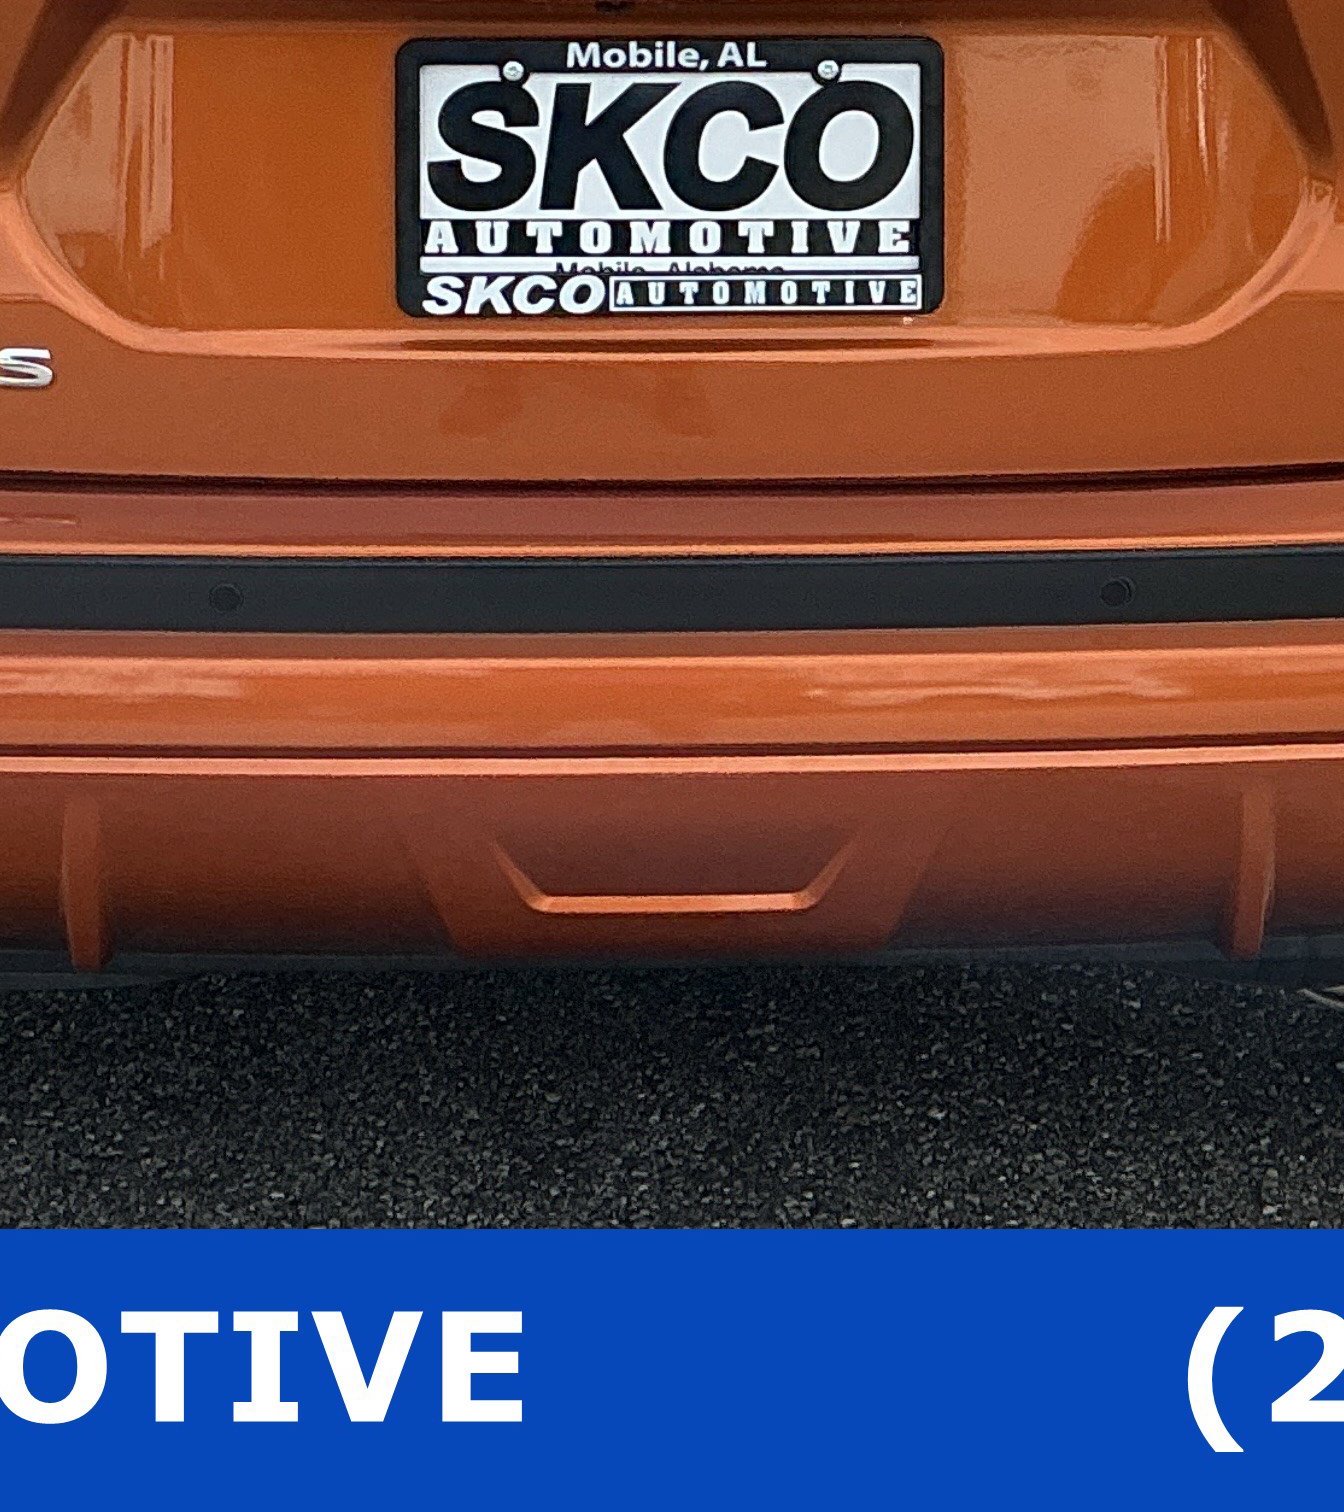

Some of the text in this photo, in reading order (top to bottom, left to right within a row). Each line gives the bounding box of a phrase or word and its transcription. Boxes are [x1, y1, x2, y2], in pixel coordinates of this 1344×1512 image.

[567, 41, 767, 71] Mobile, AL
[426, 79, 914, 212] SKCO
[424, 220, 911, 254] AUTOMOTIVE
[422, 274, 917, 316] SKCO AUTOMOTIVE
